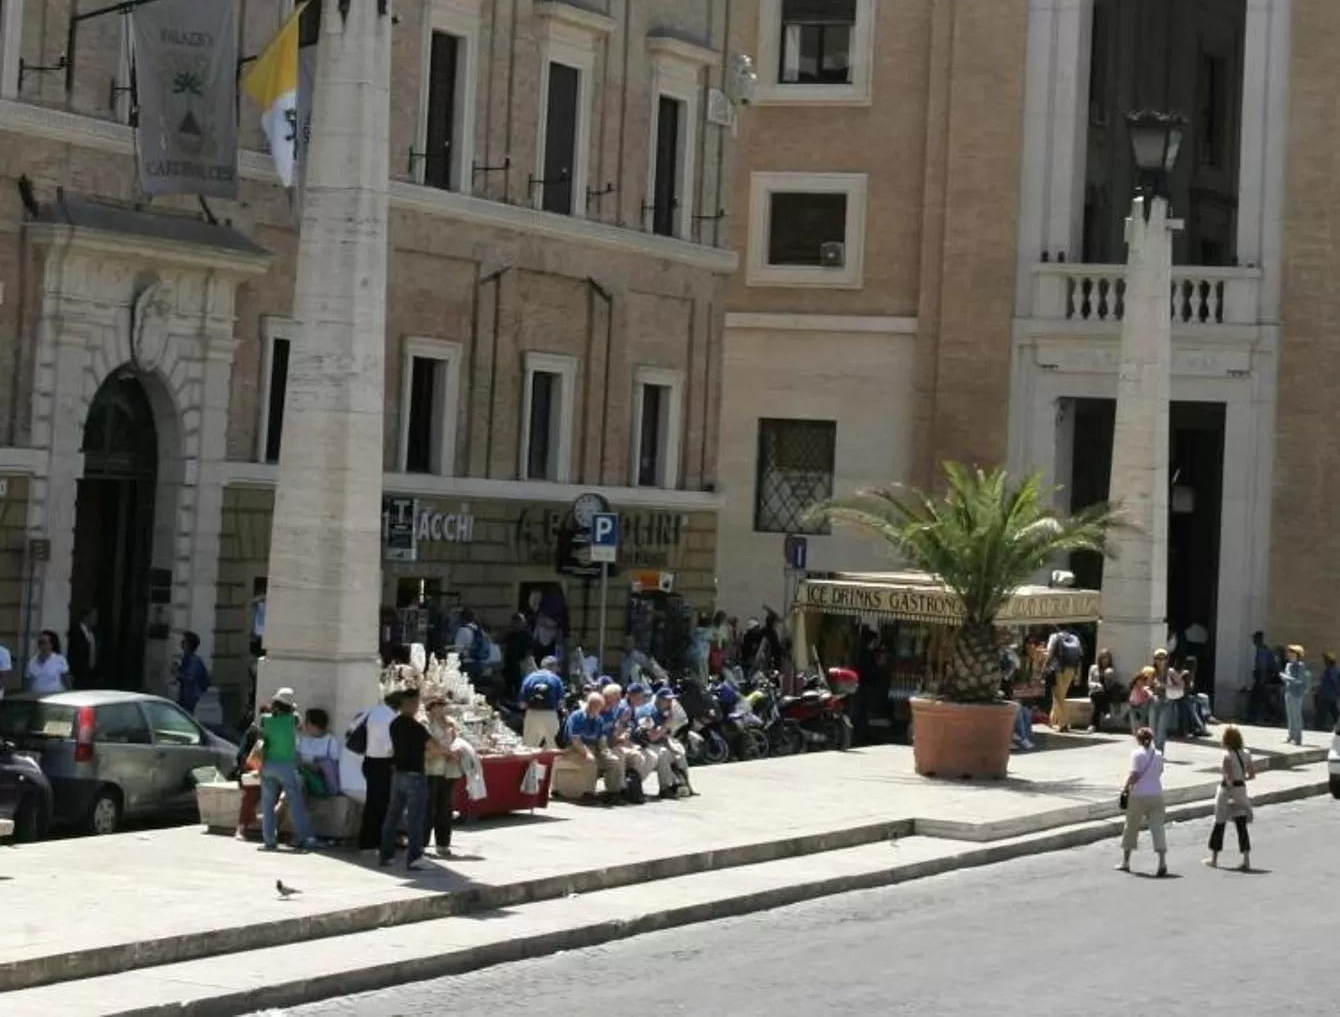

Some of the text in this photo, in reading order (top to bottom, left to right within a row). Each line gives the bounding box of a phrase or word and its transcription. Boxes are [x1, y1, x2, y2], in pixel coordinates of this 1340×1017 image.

[595, 517, 613, 543] P
[806, 584, 829, 604] ICE
[832, 587, 882, 610] DRINKS
